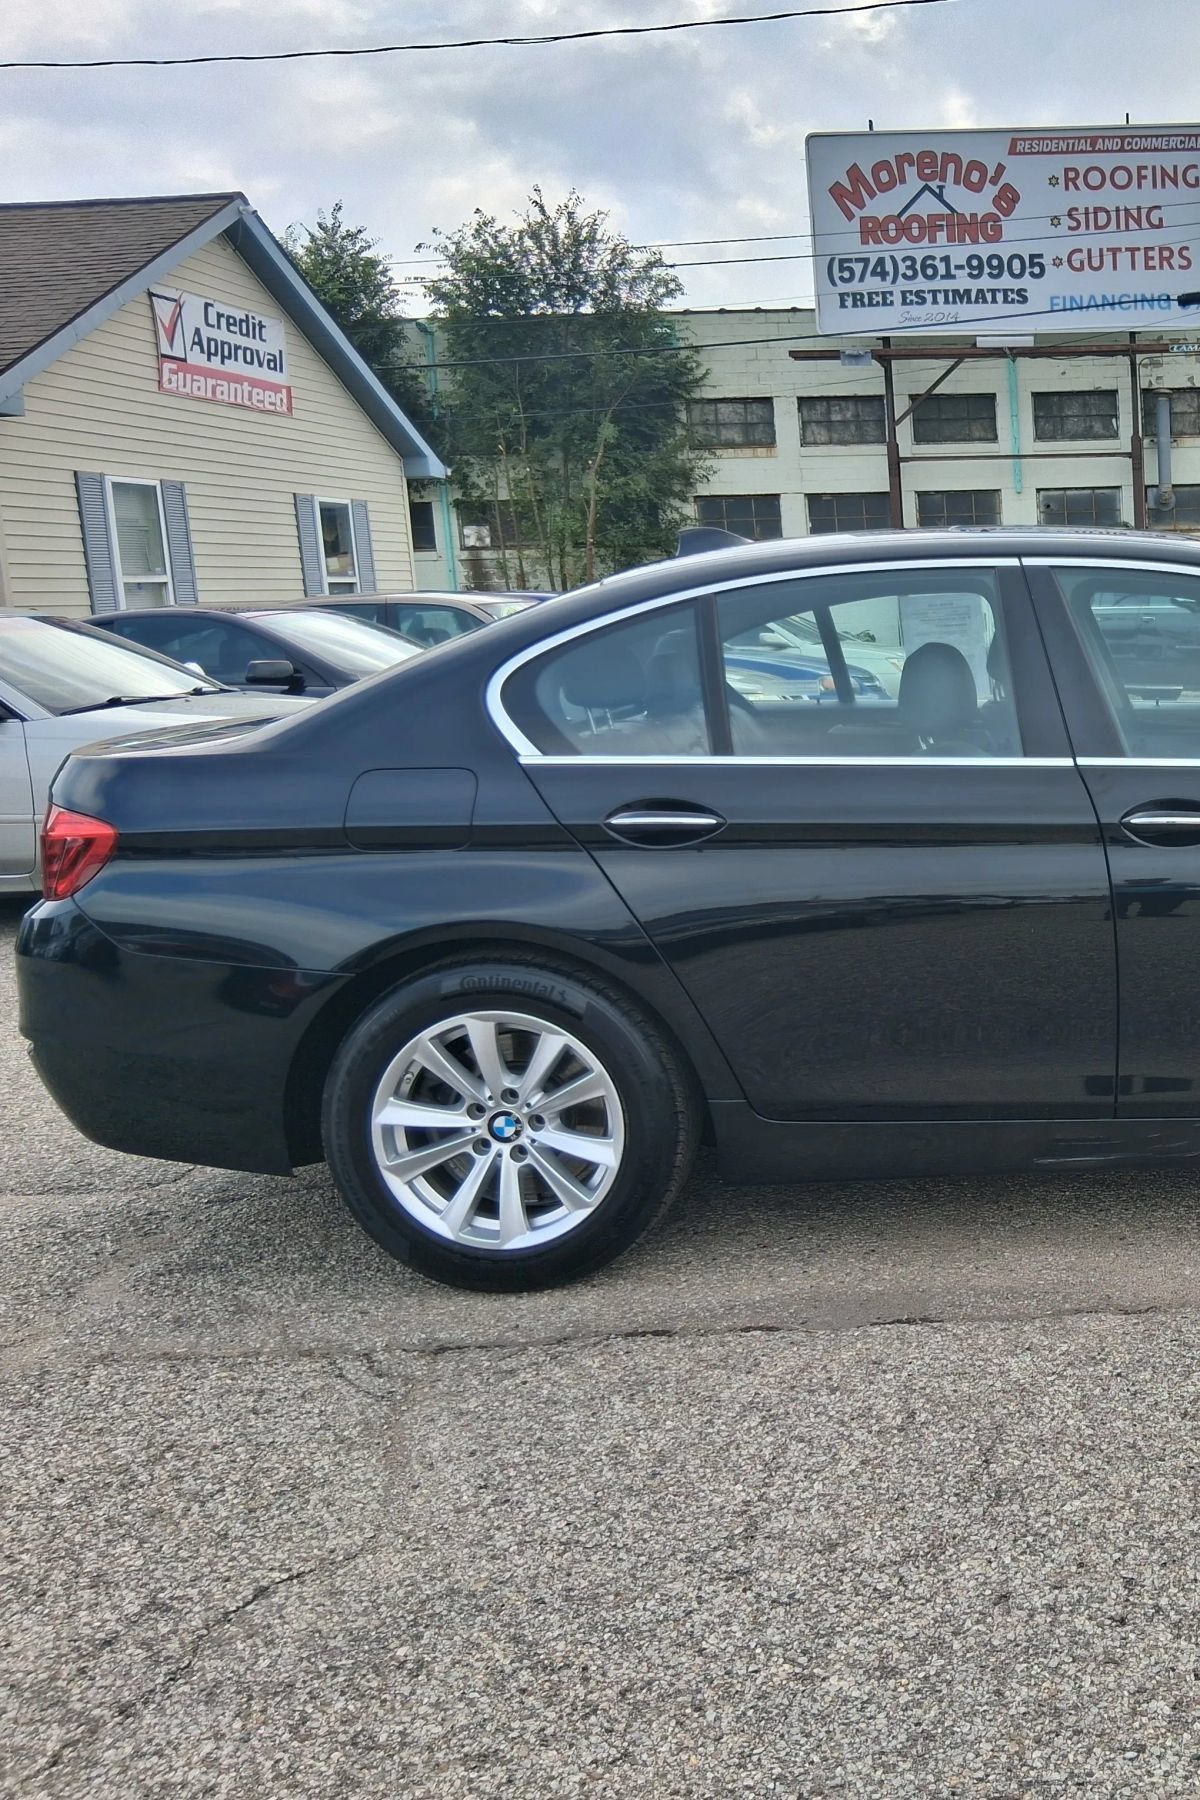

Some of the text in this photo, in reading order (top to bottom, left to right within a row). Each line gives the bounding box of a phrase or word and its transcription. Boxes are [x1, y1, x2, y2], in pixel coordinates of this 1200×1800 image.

[1016, 138, 1092, 153] RESIDENTIAL
[1095, 138, 1121, 151] AND
[828, 150, 1021, 222] Moreno's
[1063, 164, 1200, 192] ROOFING
[859, 212, 1003, 245] ROOFING
[1066, 205, 1164, 231] SIDING
[826, 253, 1046, 287] (574)361-9905
[1066, 246, 1193, 272] GUTTERS
[838, 288, 1029, 309] FREE ESTIMATES
[1049, 293, 1171, 311] FINANCING
[203, 301, 267, 343] Credit
[924, 311, 960, 322] 2014
[190, 327, 284, 374] Approval
[162, 362, 288, 412] Guaranteed
